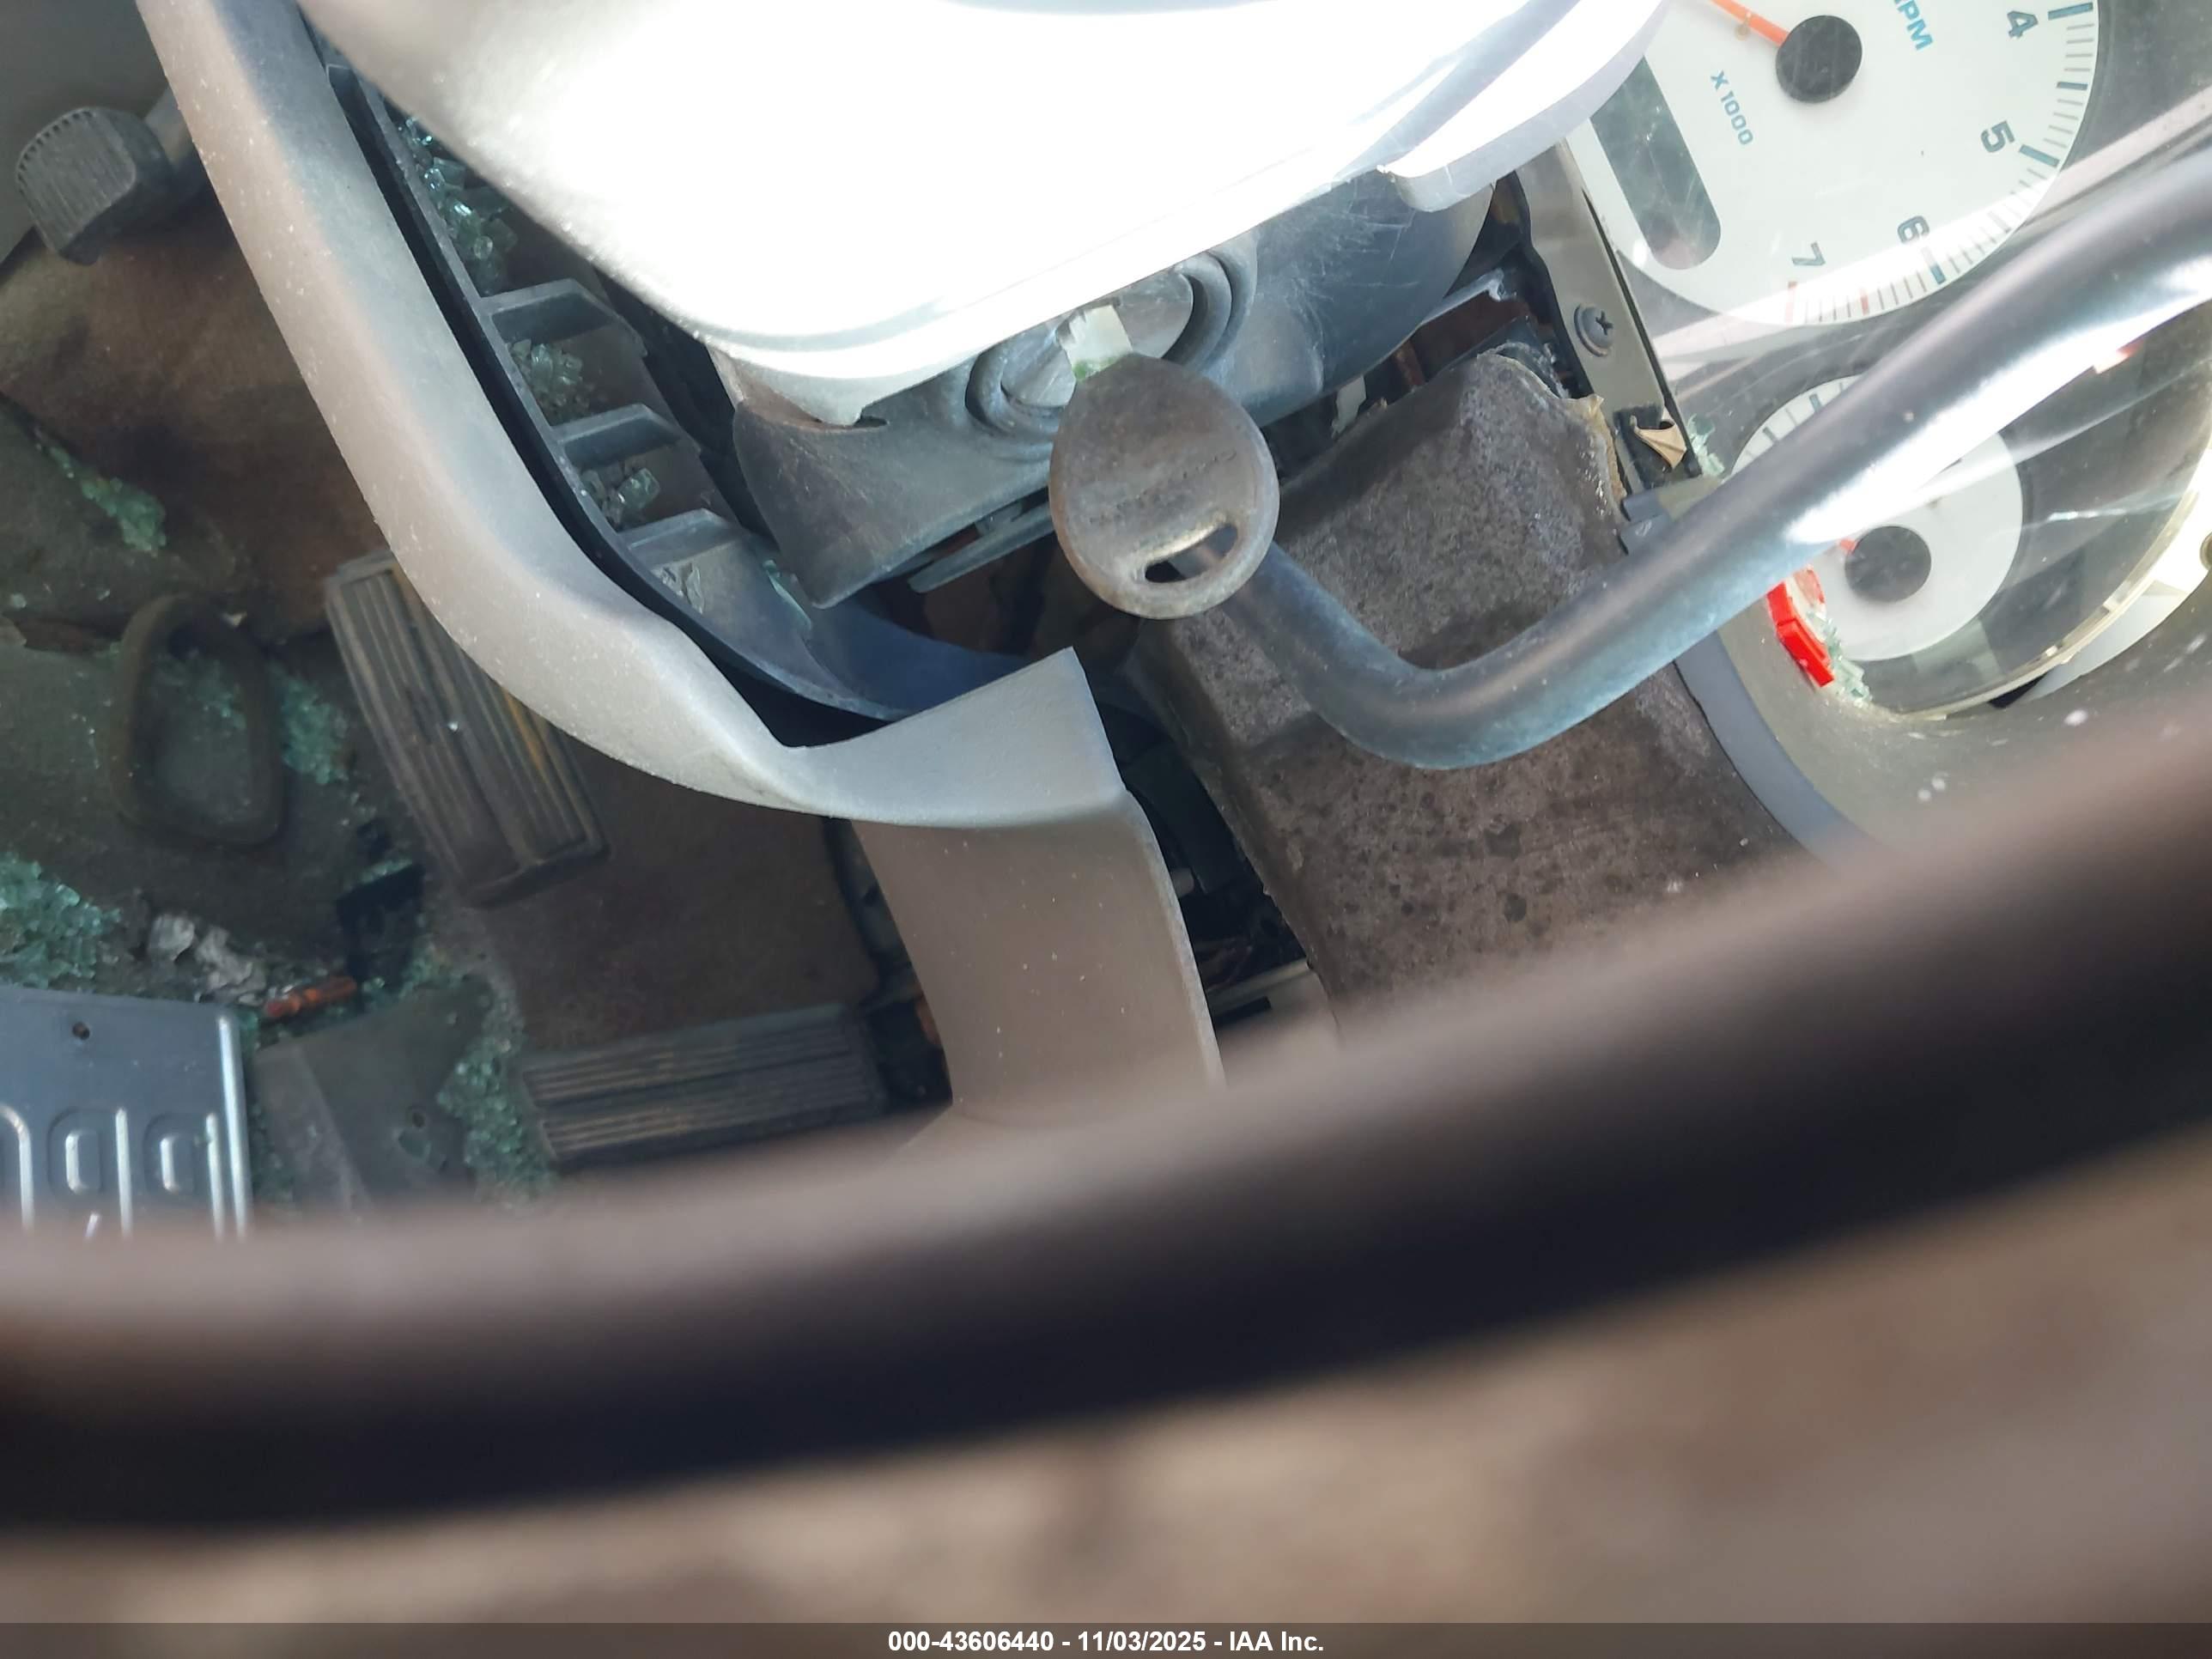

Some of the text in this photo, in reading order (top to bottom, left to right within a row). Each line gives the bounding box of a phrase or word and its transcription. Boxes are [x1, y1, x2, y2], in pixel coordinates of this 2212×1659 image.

[1894, 0, 1933, 51] PM
[2007, 10, 2039, 39] 4
[1720, 90, 1753, 145] 1000
[1980, 120, 2015, 153] 5
[1897, 216, 1929, 244] 6
[1791, 241, 1826, 266] 7
